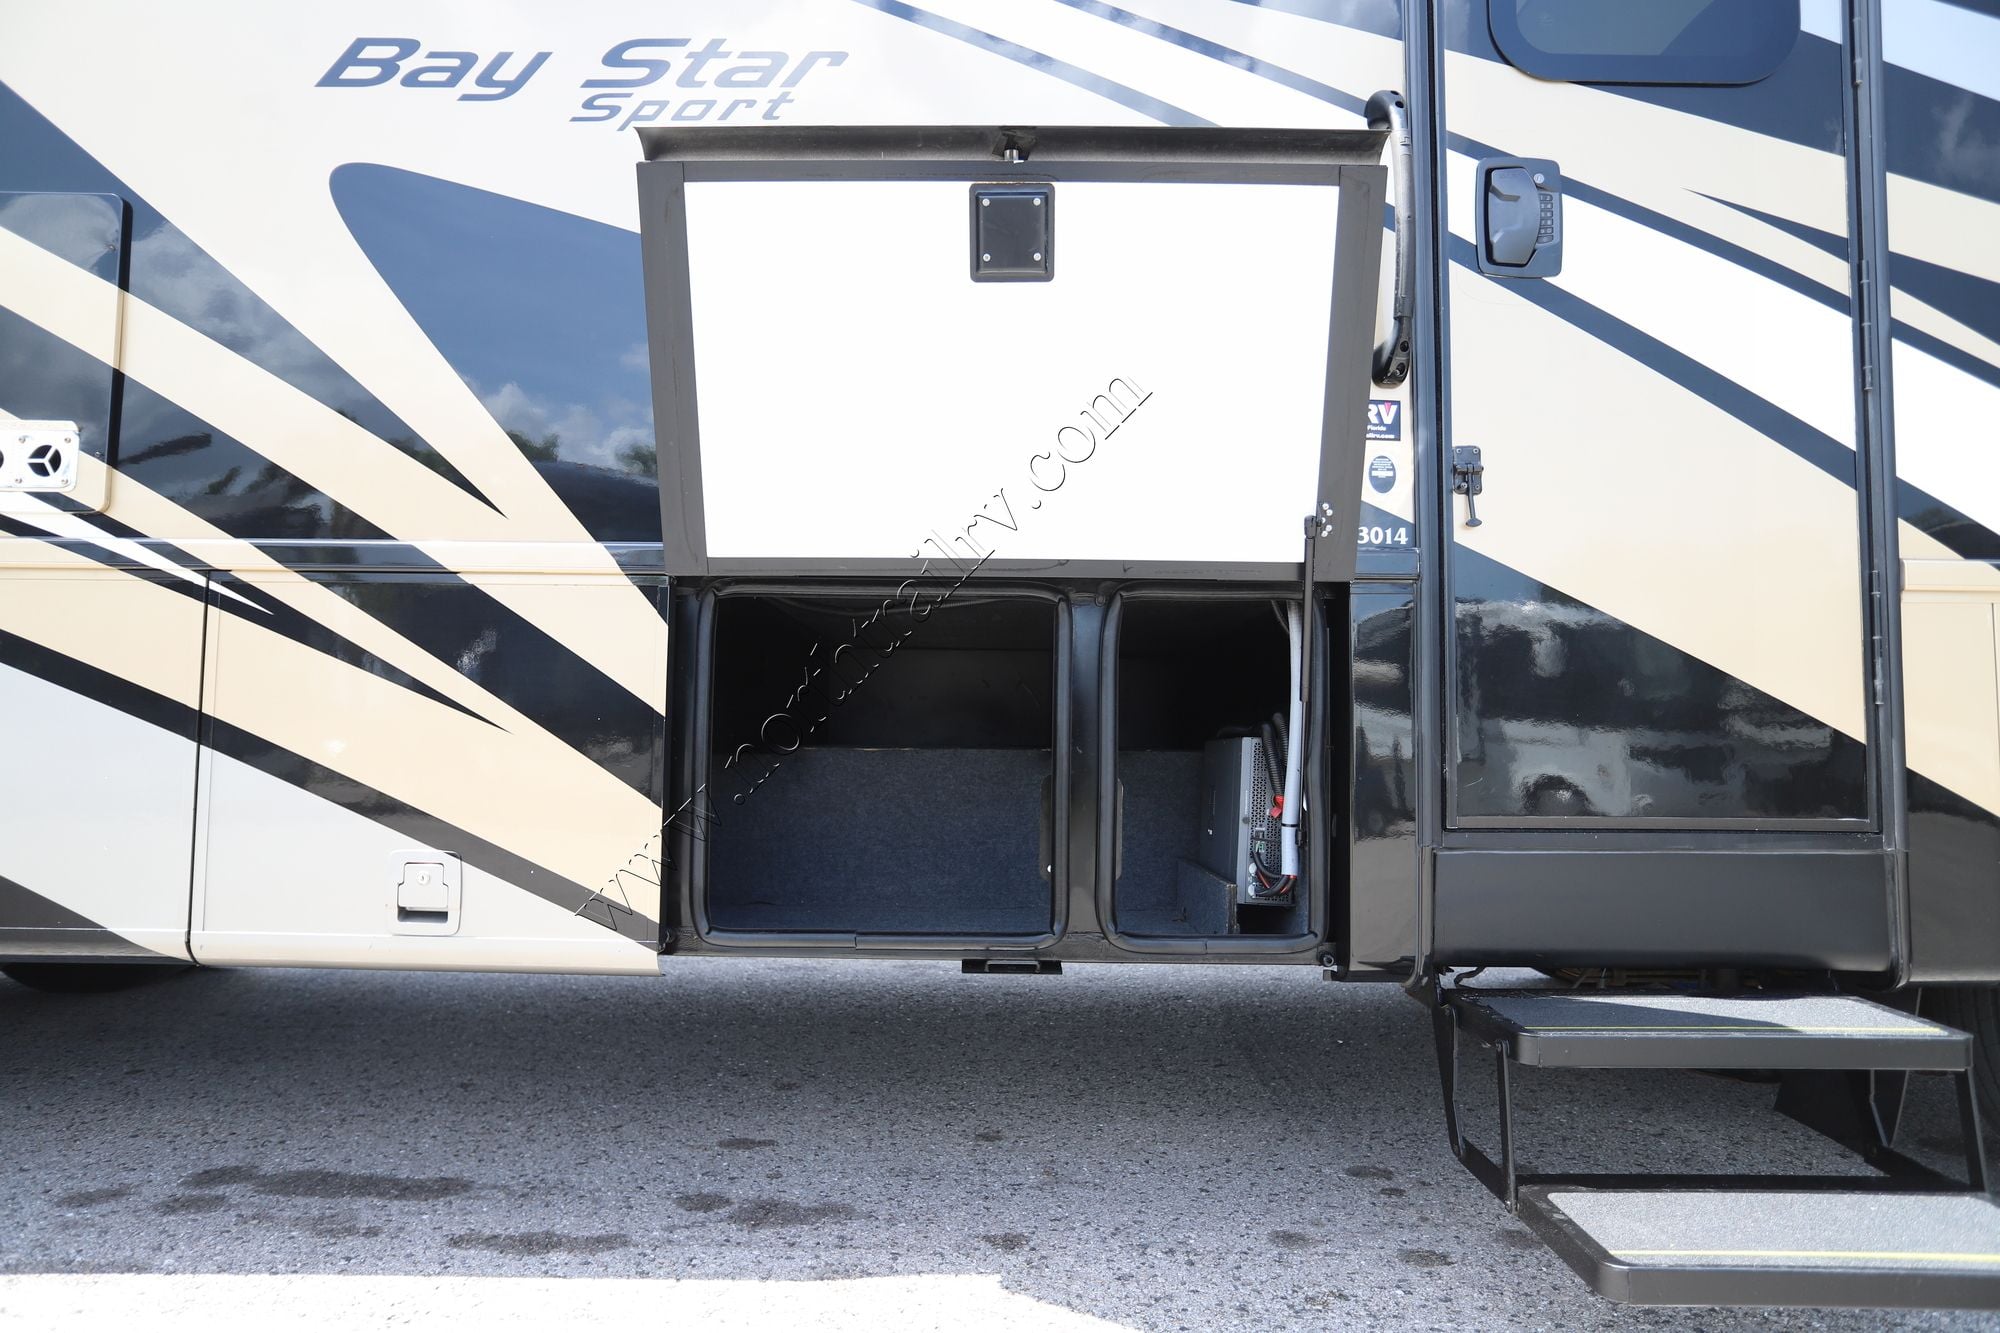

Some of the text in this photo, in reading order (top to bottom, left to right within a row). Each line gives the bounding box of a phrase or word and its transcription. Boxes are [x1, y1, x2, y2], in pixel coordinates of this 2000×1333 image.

[314, 37, 850, 102] Bay Star
[568, 91, 796, 132] Sport
[1367, 402, 1398, 425] RV
[1357, 526, 1409, 545] 3014
